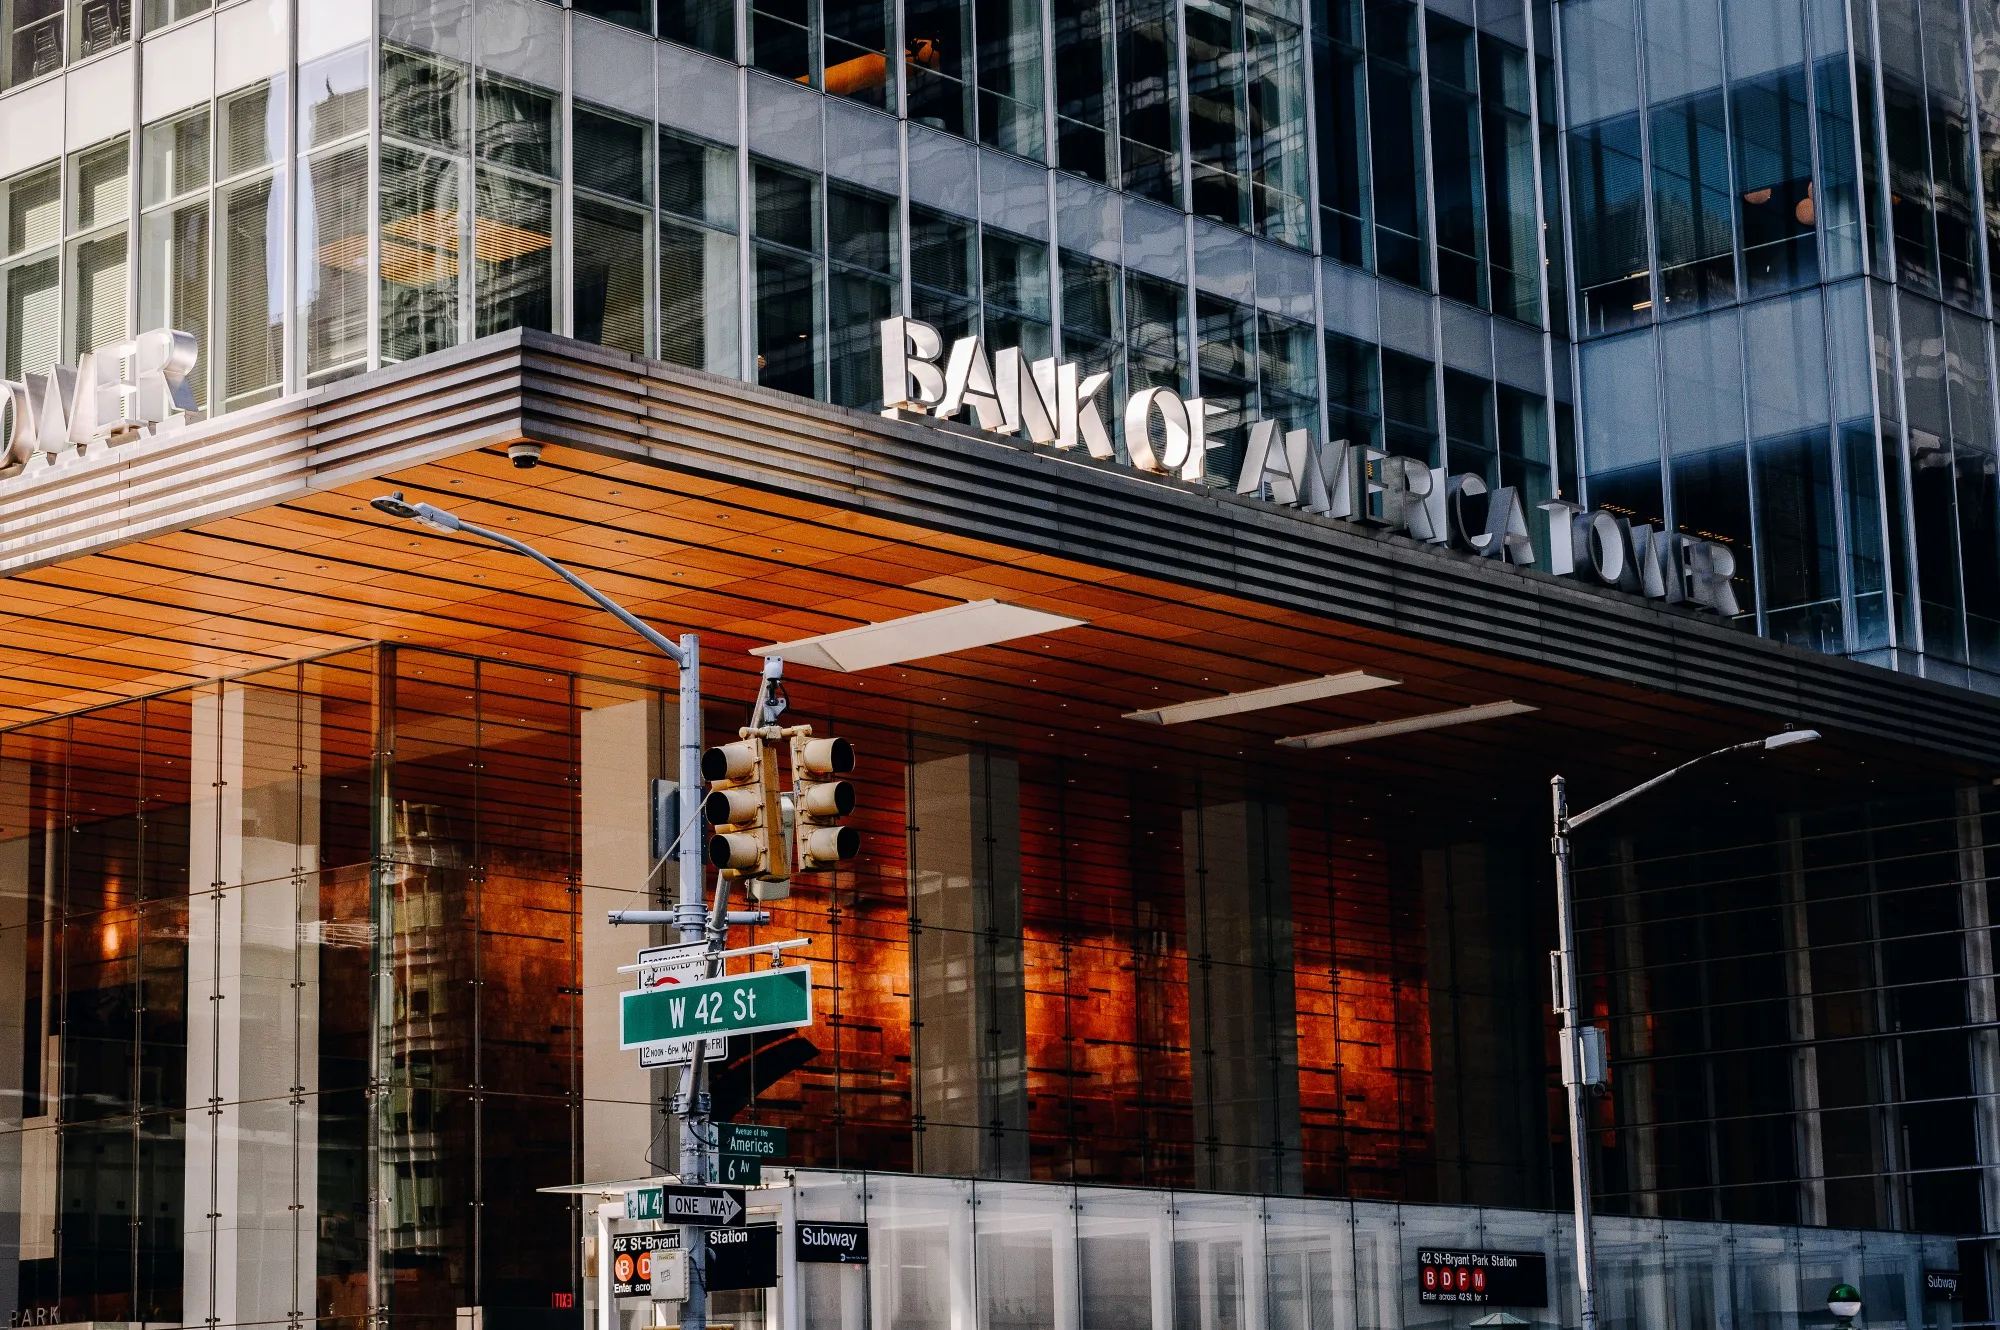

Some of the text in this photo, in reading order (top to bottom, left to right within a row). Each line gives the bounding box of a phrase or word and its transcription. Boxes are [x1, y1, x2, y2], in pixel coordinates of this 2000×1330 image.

[881, 316, 1741, 617] BANK OF AMERICA TOWER
[669, 988, 756, 1029] W 42 St
[711, 1038, 723, 1049] FRI
[735, 1127, 769, 1137] Avenue of the
[730, 1136, 774, 1153] Americas
[728, 1160, 750, 1181] 6 Av
[638, 1193, 649, 1215] W
[675, 1197, 734, 1216] ONE WAY
[613, 1230, 748, 1251] 42 St-Bryant Station
[802, 1227, 857, 1251] Subway
[620, 1258, 651, 1276] B D
[1421, 1252, 1517, 1267] 42 St-Bryant Park Station
[614, 1283, 633, 1293] Enter
[1426, 1271, 1483, 1287] B D F M
[1927, 1274, 1957, 1292] Subway
[1422, 1291, 1437, 1300] Enter
[1439, 1293, 1456, 1301] across
[9, 1305, 60, 1328] PARK
